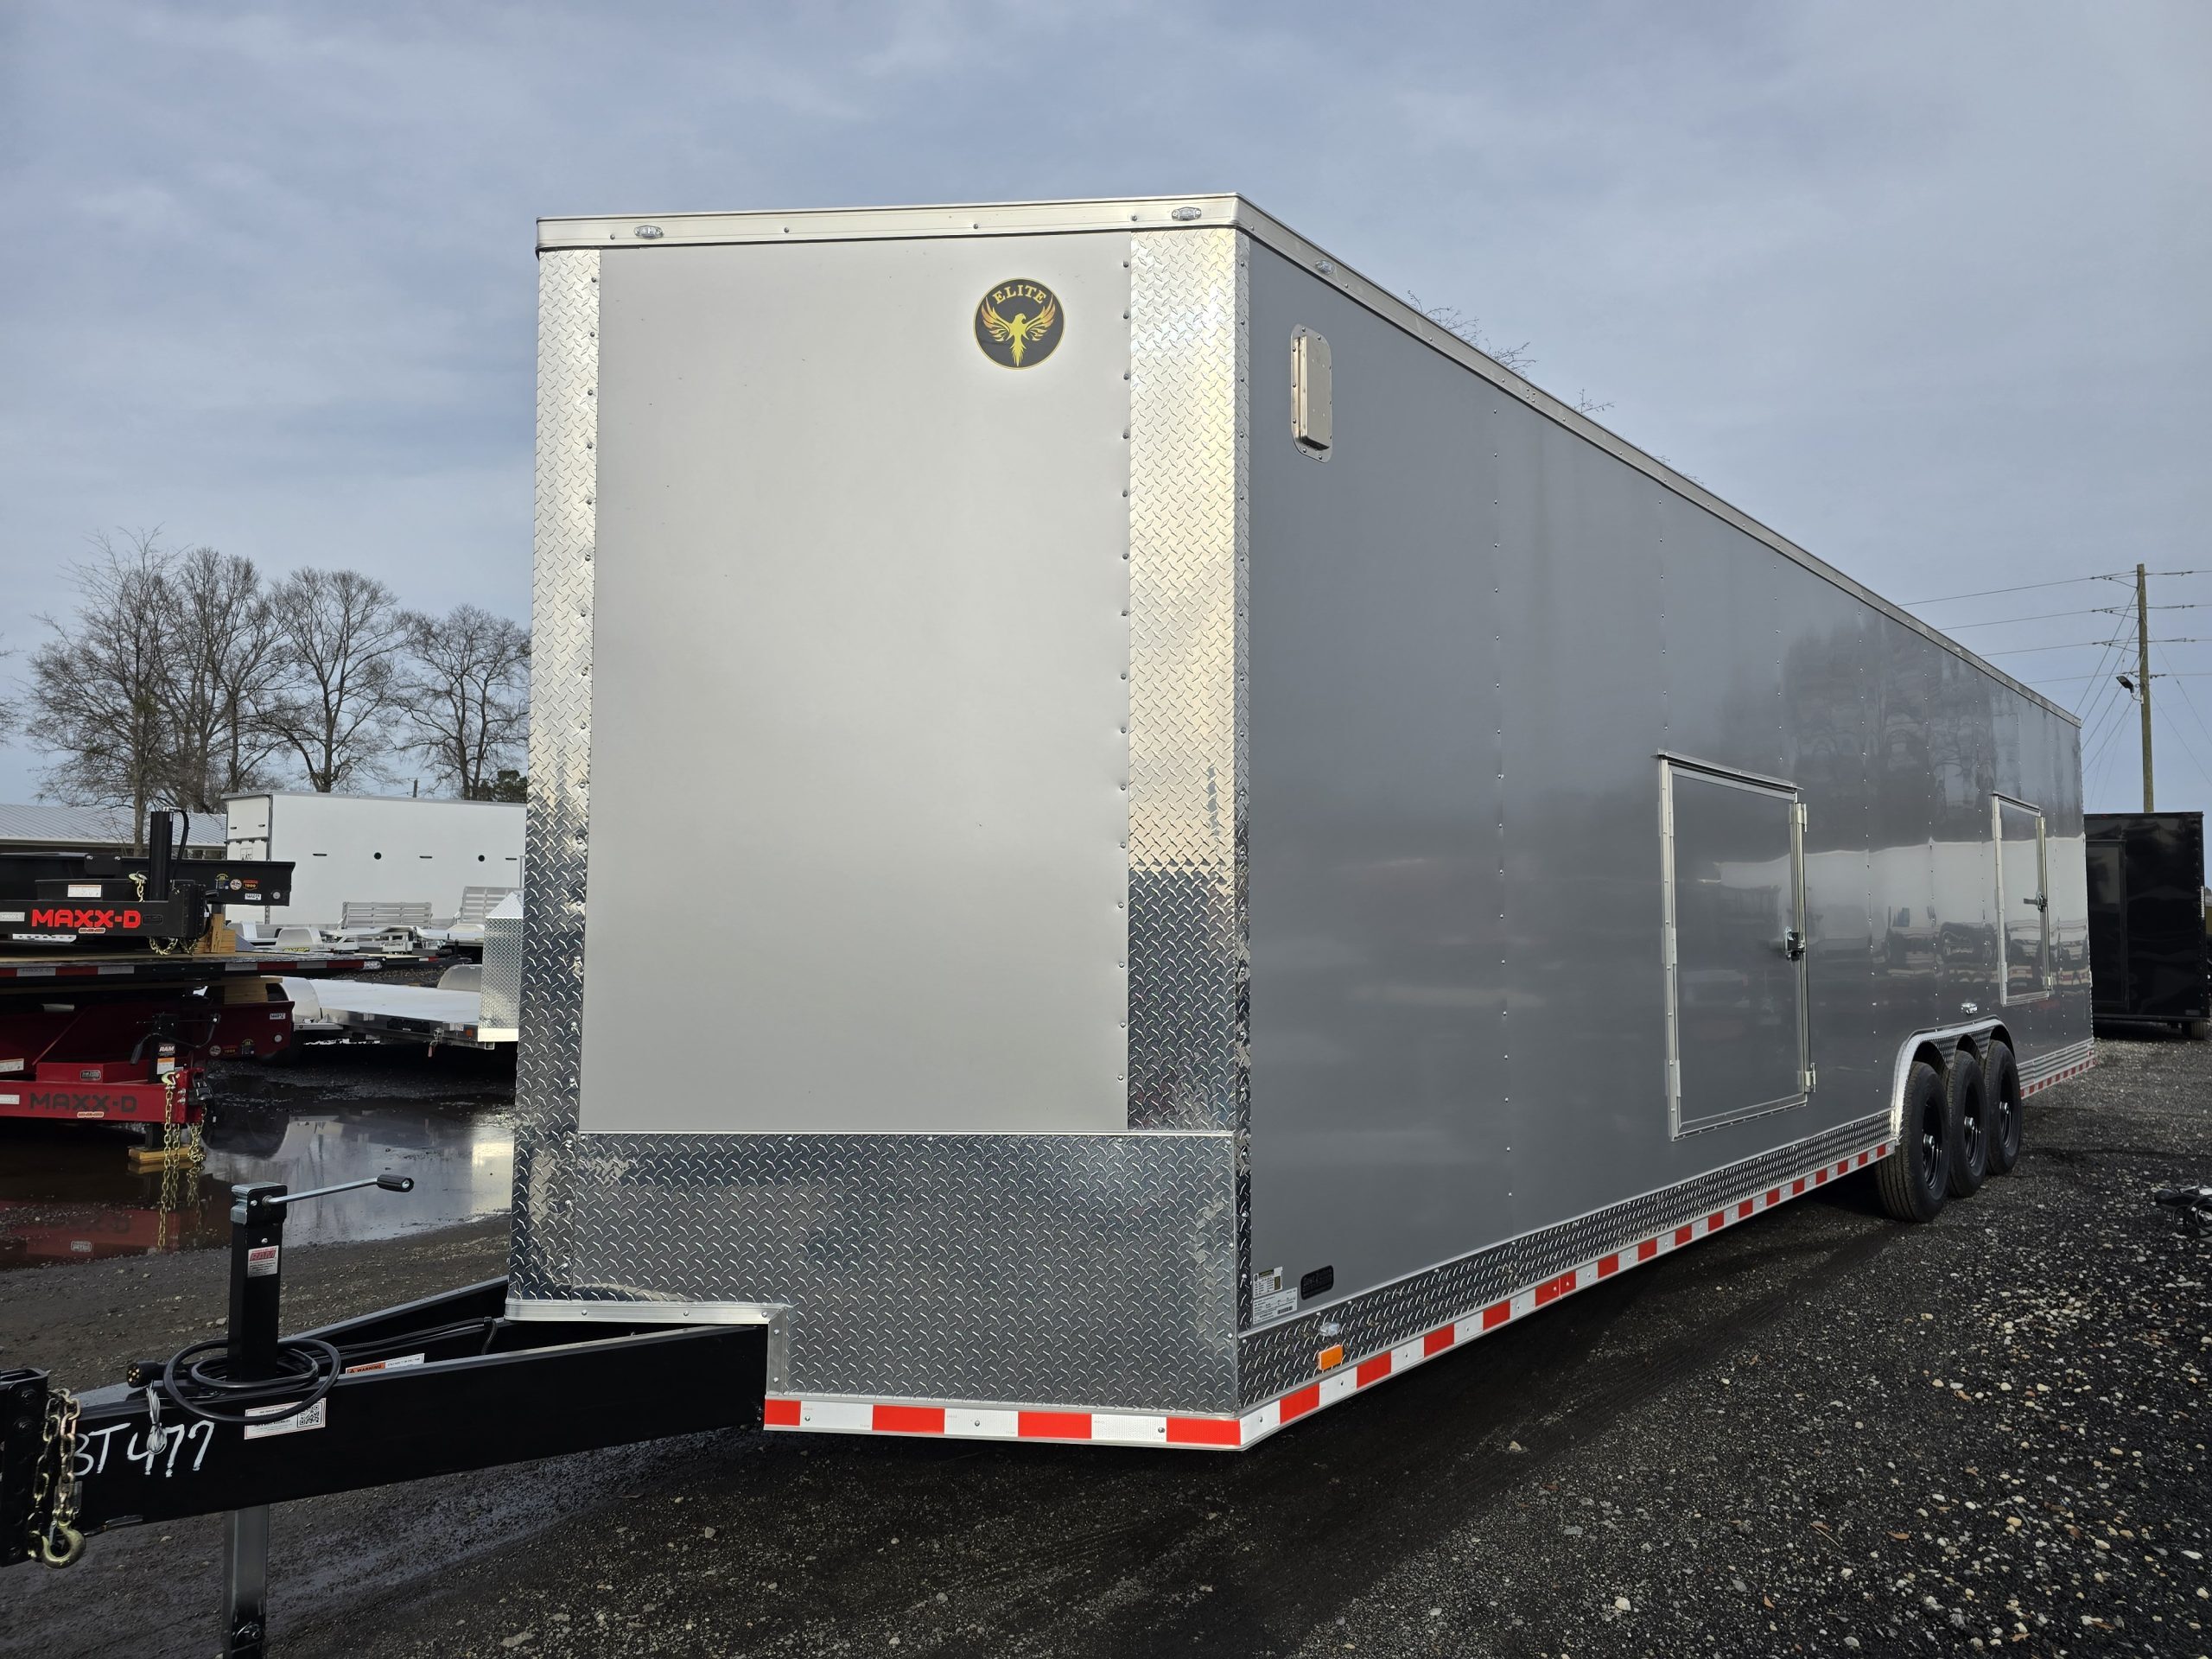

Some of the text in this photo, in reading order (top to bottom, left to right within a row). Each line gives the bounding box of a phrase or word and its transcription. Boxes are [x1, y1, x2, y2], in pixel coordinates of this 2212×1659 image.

[992, 284, 1047, 304] ELITE
[31, 909, 142, 929] MAXX-D
[29, 1092, 137, 1113] MAXX-D
